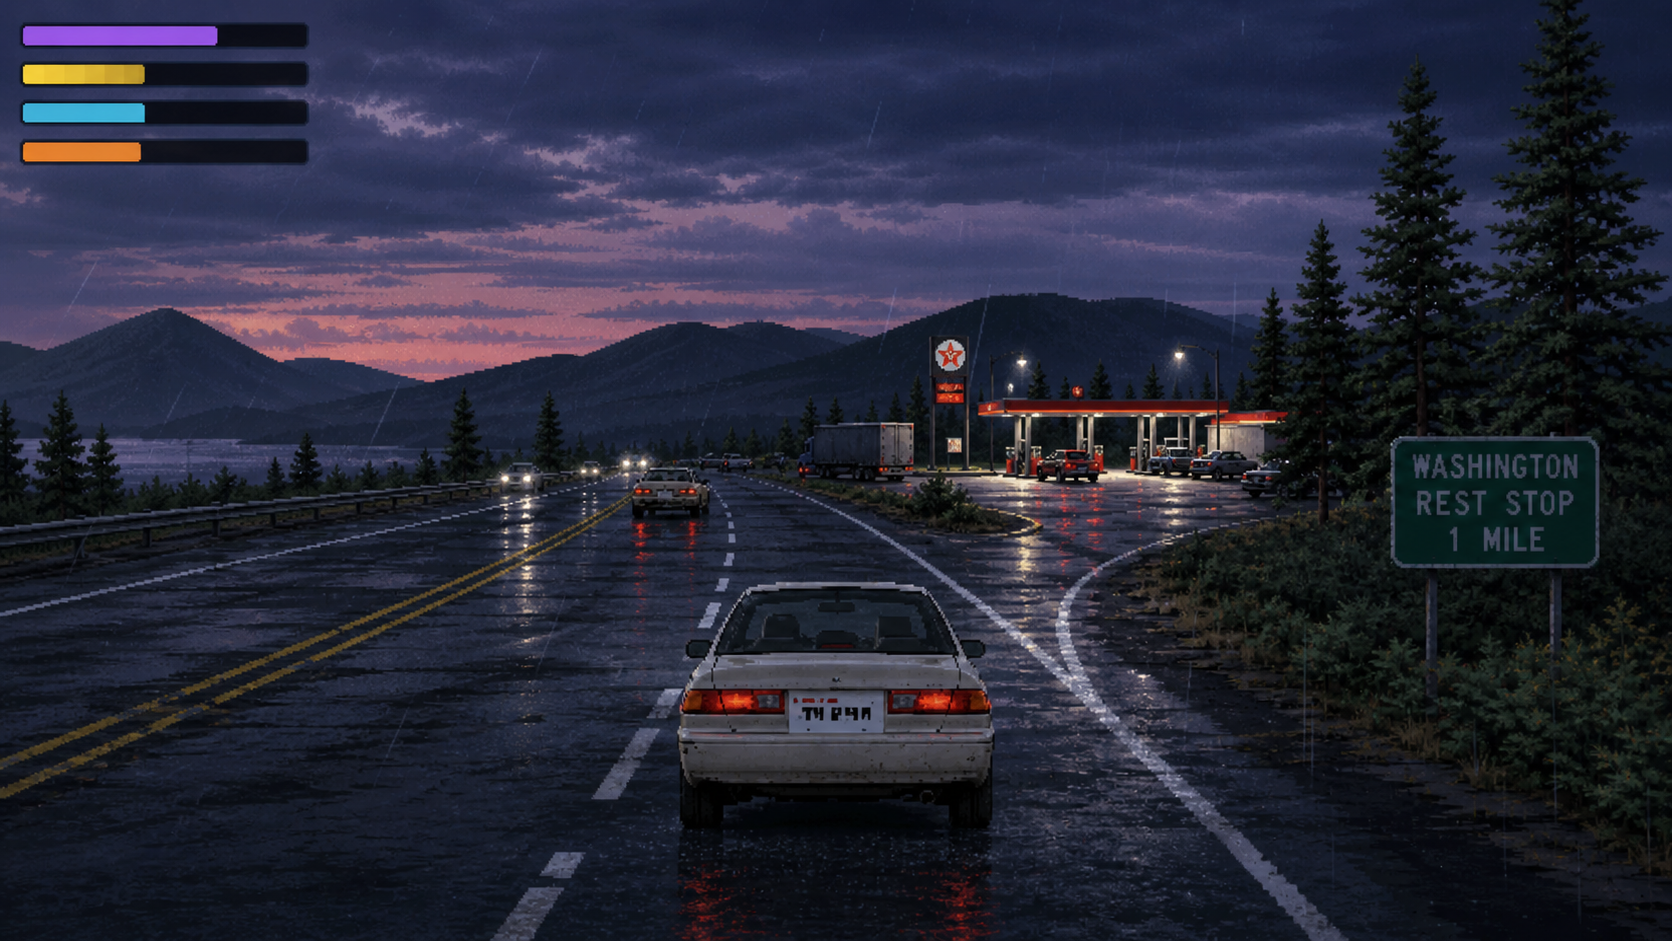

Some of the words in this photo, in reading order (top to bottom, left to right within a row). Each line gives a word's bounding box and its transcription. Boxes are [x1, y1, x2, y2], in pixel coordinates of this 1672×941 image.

[1412, 453, 1579, 479] WASHINGTON
[1416, 490, 1487, 516] REST
[1506, 490, 1574, 516] STOP
[1449, 526, 1458, 552] 1
[1483, 526, 1545, 552] MILE
